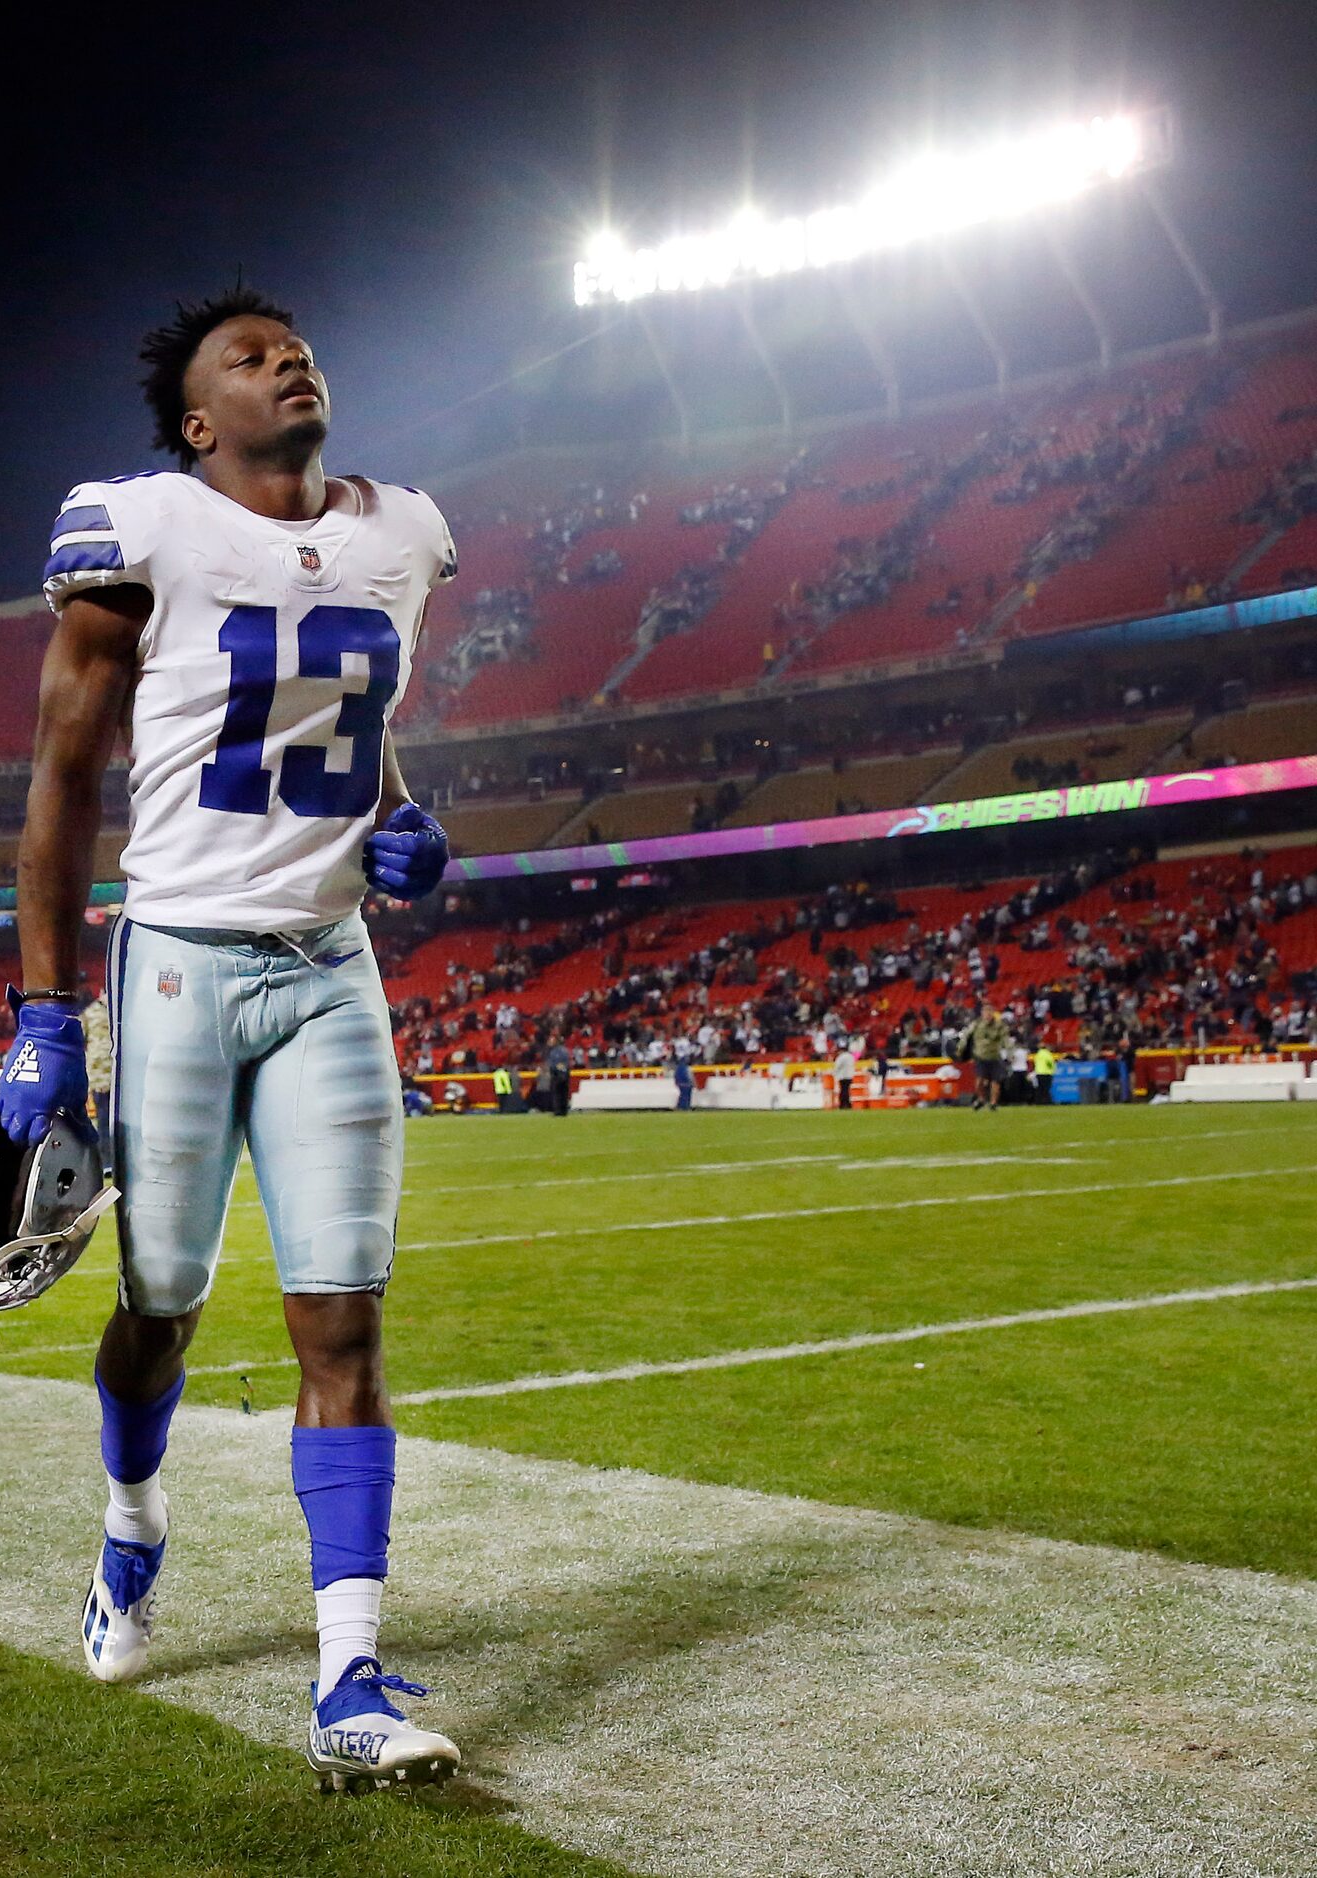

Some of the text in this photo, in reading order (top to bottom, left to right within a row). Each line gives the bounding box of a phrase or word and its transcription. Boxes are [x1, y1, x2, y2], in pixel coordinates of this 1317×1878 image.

[198, 605, 401, 818] 13
[933, 778, 1146, 832] CHIEFS WIN
[5, 1040, 35, 1084] adidas
